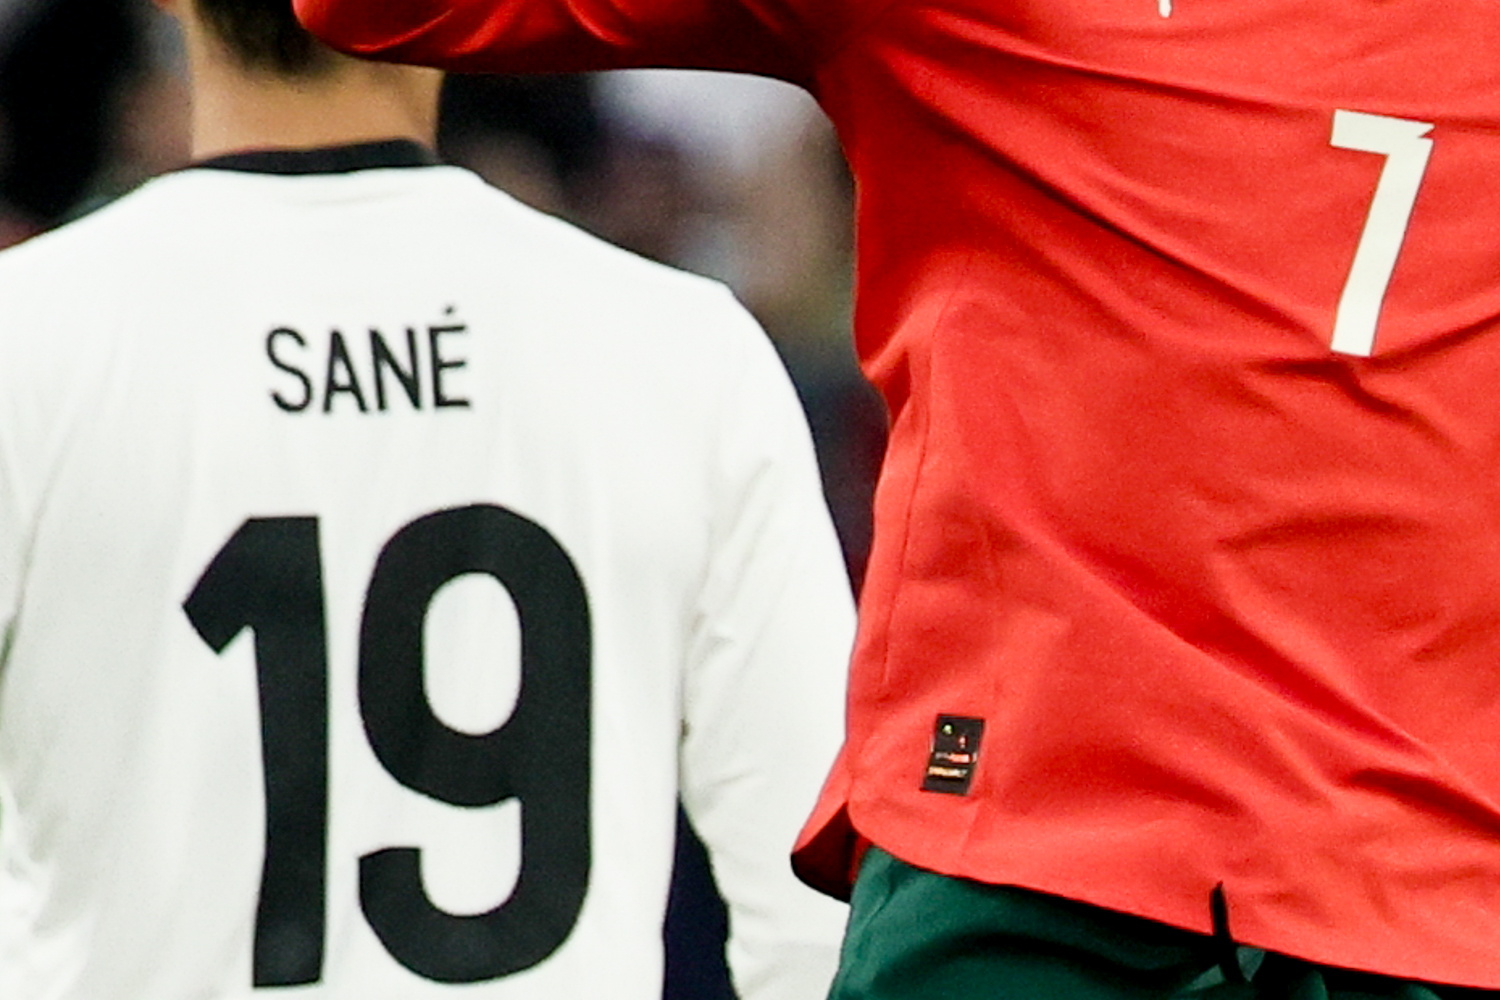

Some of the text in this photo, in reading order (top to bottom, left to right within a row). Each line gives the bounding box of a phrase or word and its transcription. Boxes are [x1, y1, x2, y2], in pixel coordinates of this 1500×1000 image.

[1330, 108, 1435, 357] 7
[266, 306, 471, 413] SANÉ
[181, 502, 593, 988] 19
